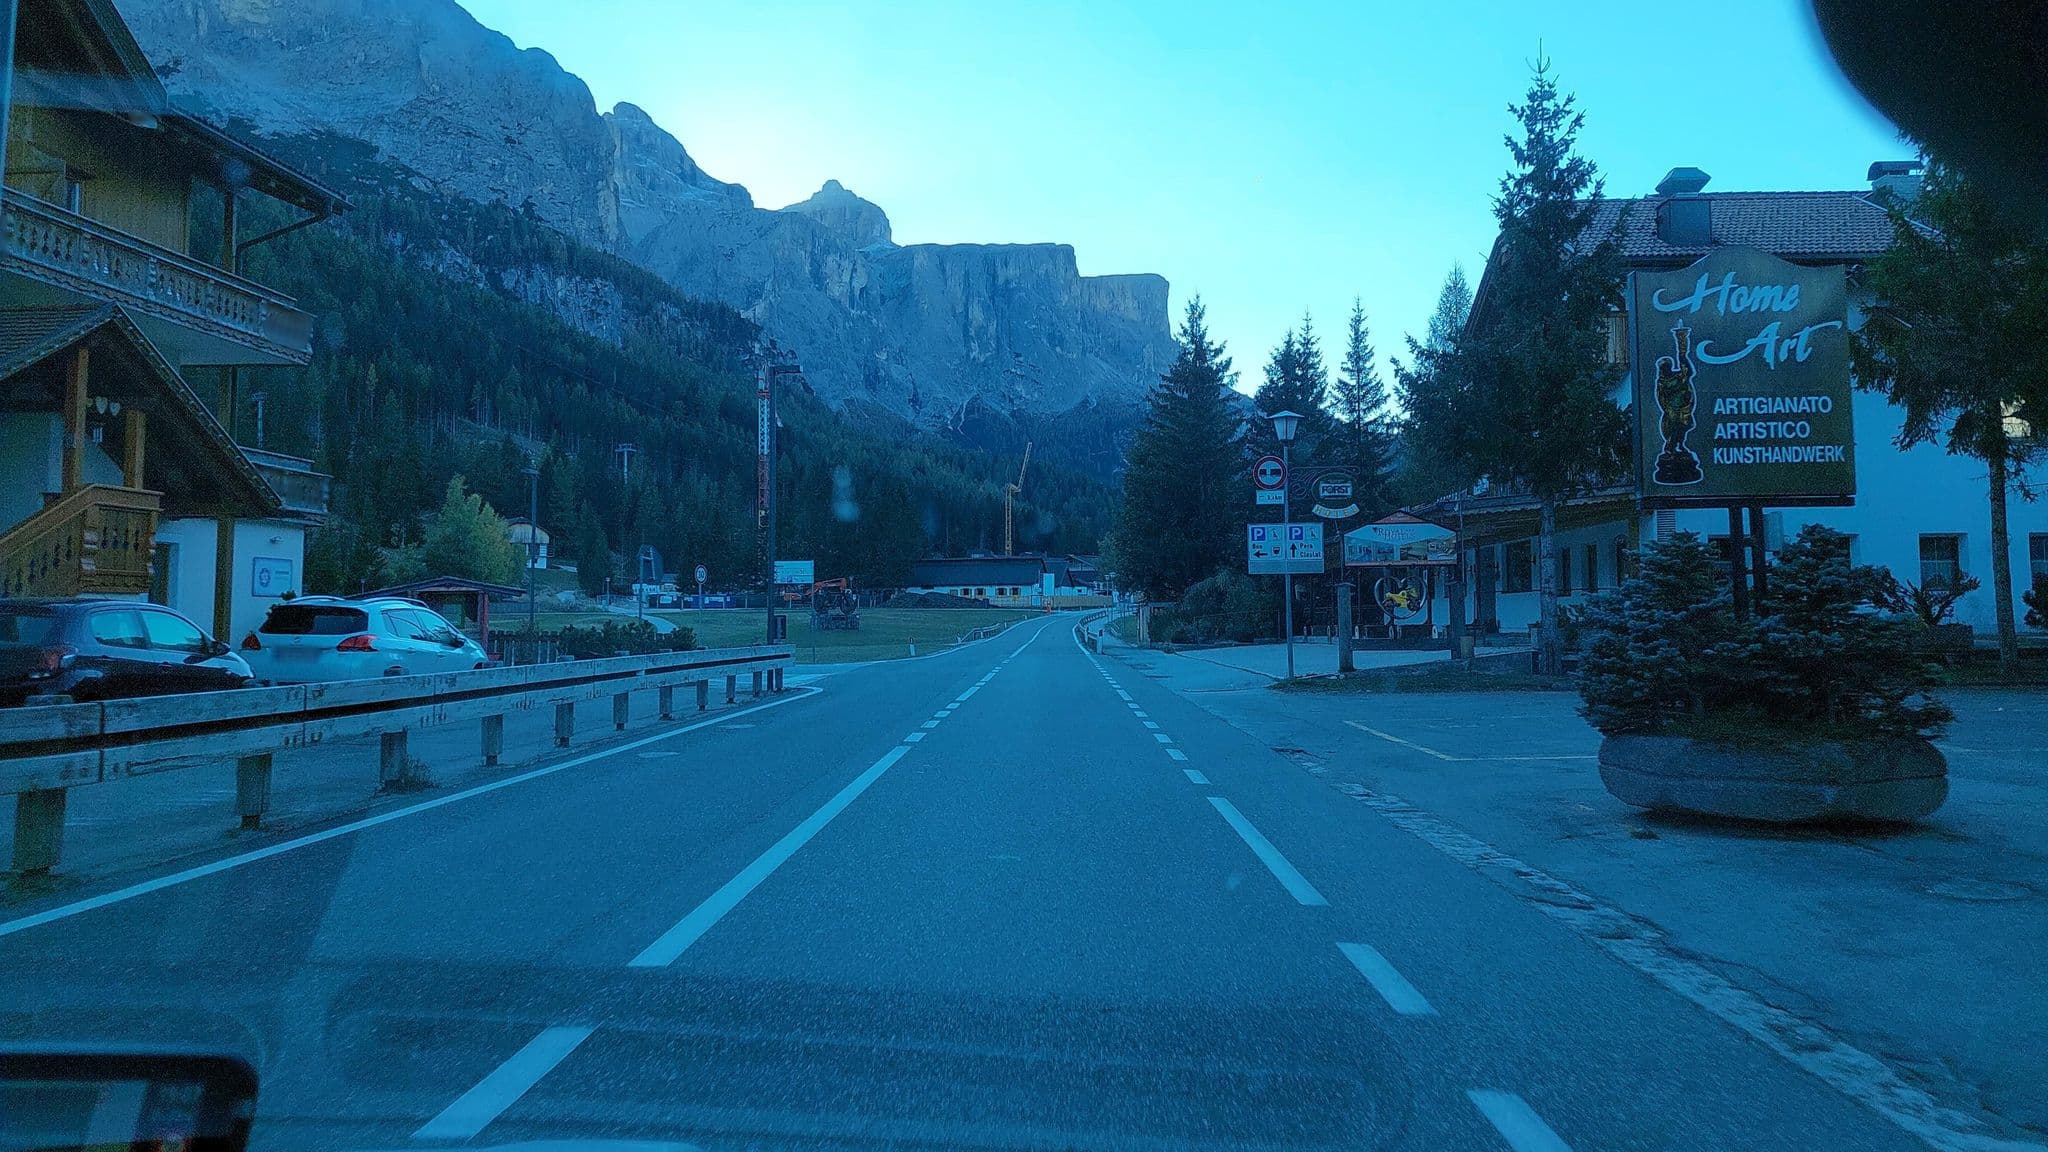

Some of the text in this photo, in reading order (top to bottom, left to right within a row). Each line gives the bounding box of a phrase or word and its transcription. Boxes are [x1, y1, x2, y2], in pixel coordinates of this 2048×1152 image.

[1652, 271, 1800, 316] Home
[1695, 321, 1843, 370] Art
[1713, 395, 1833, 415] ARTIGIANATO
[1714, 421, 1811, 439] ARTISTICO
[1713, 445, 1846, 465] KUNSTHANDWERK
[1253, 528, 1264, 541] P
[1291, 527, 1301, 540] P
